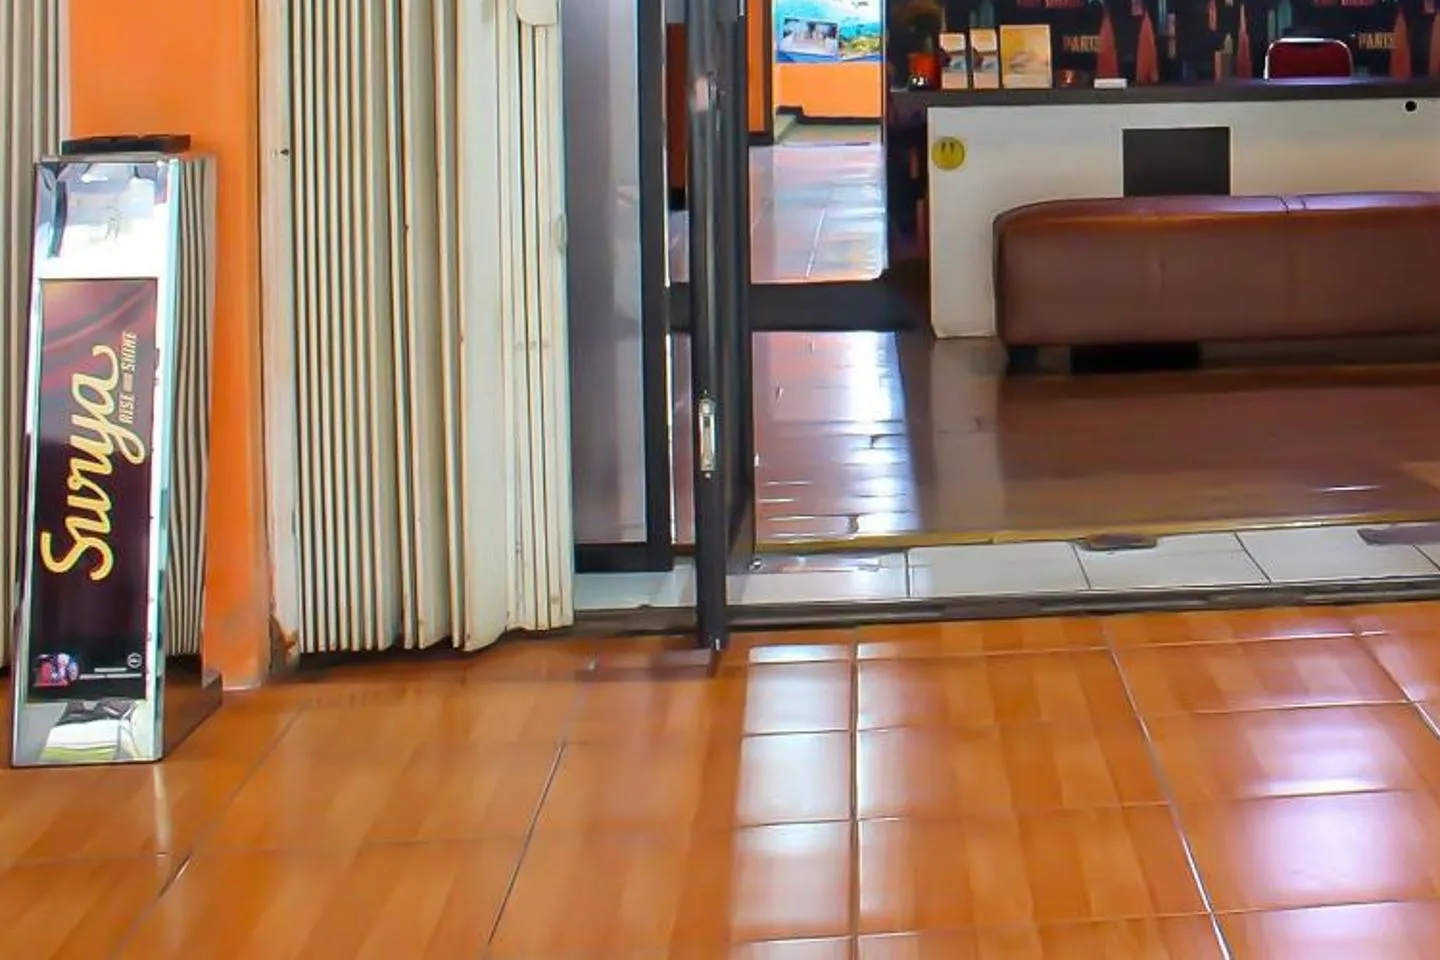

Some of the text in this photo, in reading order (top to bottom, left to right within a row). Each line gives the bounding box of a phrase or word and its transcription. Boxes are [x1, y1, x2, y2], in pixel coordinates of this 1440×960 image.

[121, 330, 138, 373] SHINE
[118, 392, 135, 424] RISE
[40, 344, 146, 581] Surya
